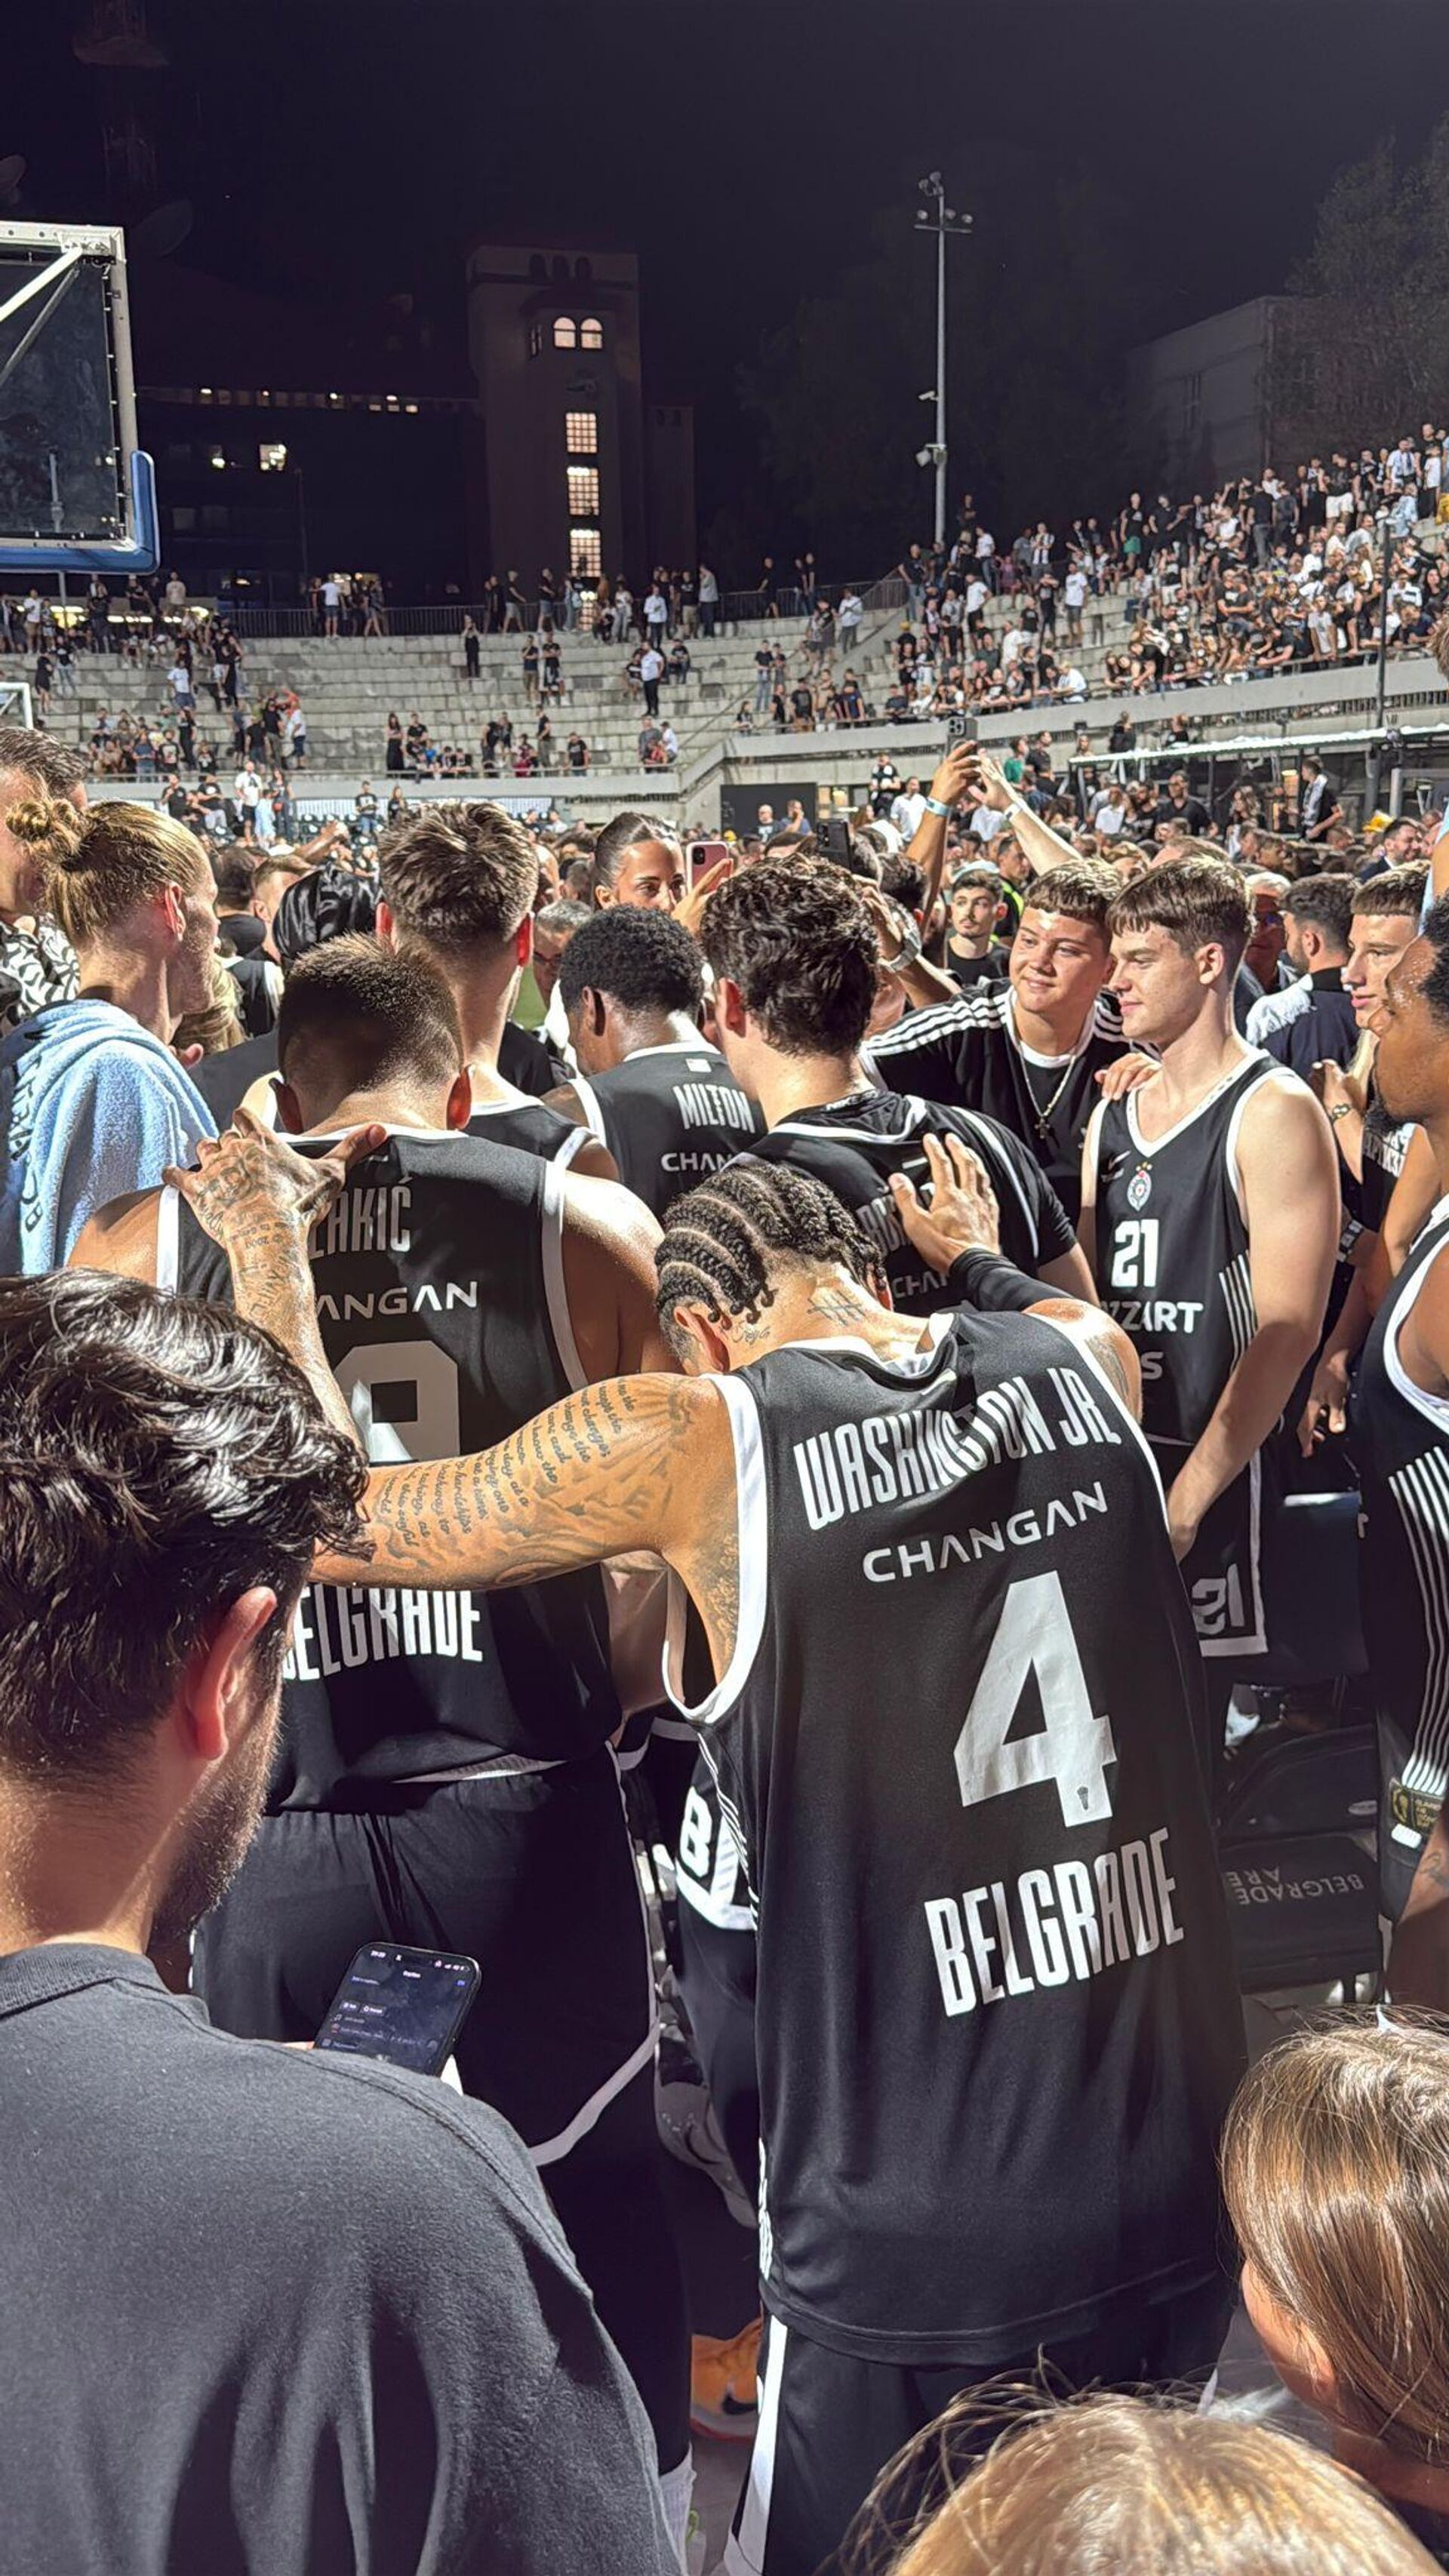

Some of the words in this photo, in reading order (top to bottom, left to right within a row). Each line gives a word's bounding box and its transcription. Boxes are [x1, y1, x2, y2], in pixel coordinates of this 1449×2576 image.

[672, 1083, 756, 1134] MILTON
[1111, 1219, 1159, 1287] 21
[316, 1280, 478, 1321] ANGAN
[792, 1376, 1056, 1531] WASHINGTON
[862, 1480, 1109, 1583] CHANGAN
[282, 1583, 483, 1682] ELGRADE
[952, 1569, 1118, 1827] 4
[1225, 1864, 1281, 1888] ARE
[1235, 1873, 1364, 1906] BELGRADE
[924, 1827, 1185, 2018] BELGRADE
